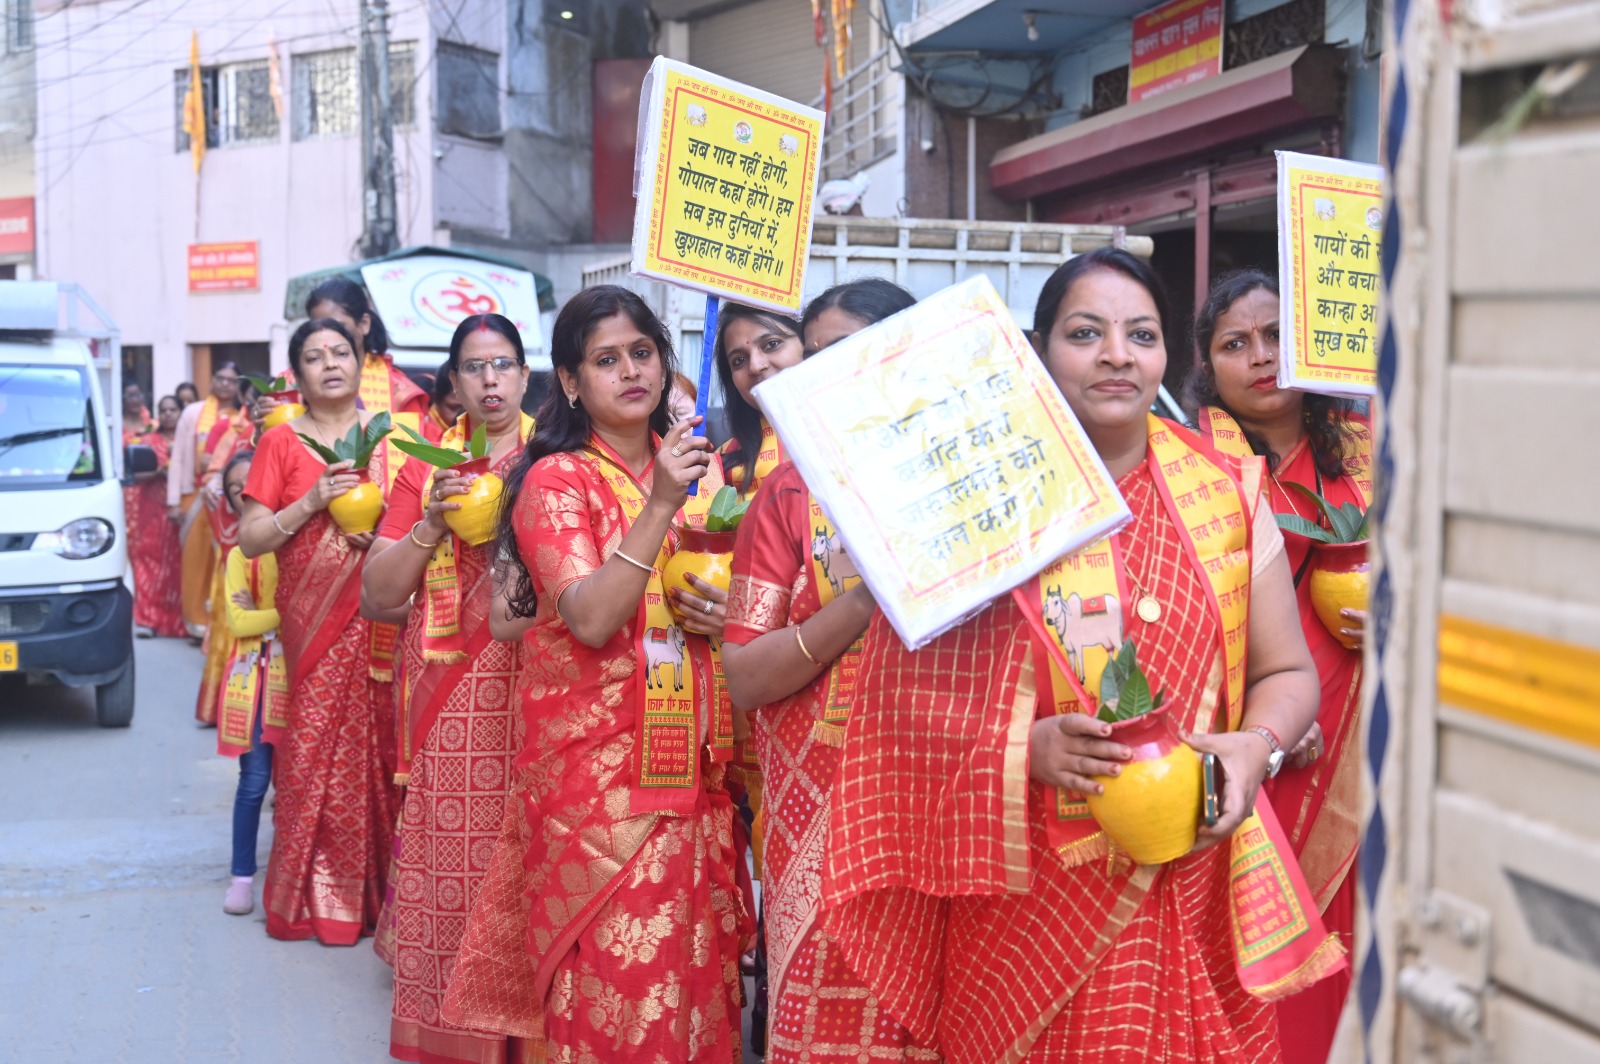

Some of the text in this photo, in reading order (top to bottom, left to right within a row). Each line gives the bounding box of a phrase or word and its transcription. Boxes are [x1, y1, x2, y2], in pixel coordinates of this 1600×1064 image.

[688, 137, 788, 189] जब गाय नहीं होगी,
[678, 161, 718, 194] गोपाल
[719, 180, 747, 204] कहां
[776, 197, 794, 217] हम
[683, 200, 705, 223] सब
[706, 207, 727, 231] इस
[674, 229, 723, 258] खुशहाल
[1314, 230, 1348, 256] गायों
[1350, 234, 1371, 260] की
[1317, 260, 1379, 292] और बचा
[1316, 298, 1357, 324] कान्हा
[1313, 329, 1343, 357] सुख
[1346, 327, 1368, 353] की
[1149, 430, 1170, 445] जय
[1008, 435, 1046, 470] को
[1163, 459, 1183, 477] जय
[1181, 449, 1198, 468] गौ
[1175, 478, 1234, 509] जय गौ माता
[810, 503, 822, 516] ज
[1190, 511, 1244, 541] जय गौ माता
[1084, 552, 1110, 569] माता
[1203, 557, 1225, 575] जय
[1217, 592, 1232, 609] जय
[1242, 827, 1265, 848] माता
